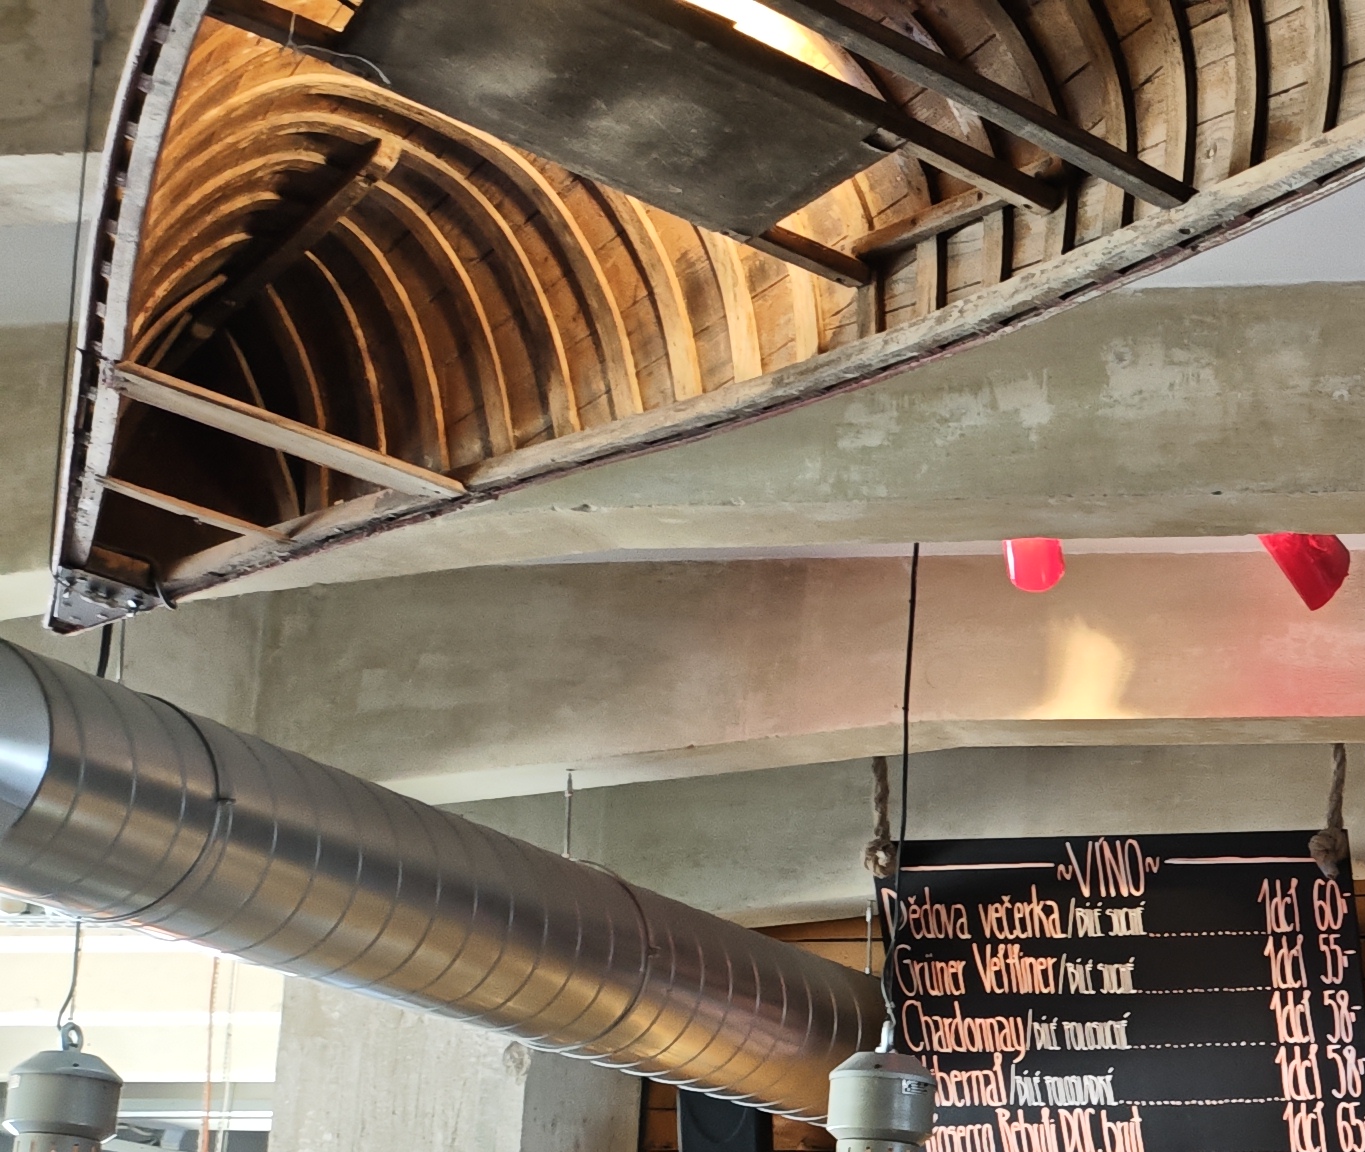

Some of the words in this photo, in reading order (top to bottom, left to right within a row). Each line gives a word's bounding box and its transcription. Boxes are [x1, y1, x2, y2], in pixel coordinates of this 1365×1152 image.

[1065, 837, 1146, 898] VÍNO
[881, 886, 972, 941] Dědova
[1257, 877, 1301, 934] 1dcl
[894, 944, 967, 996] Grüner
[1263, 933, 1308, 989] 1dcl
[1270, 990, 1316, 1044] 1dcl
[1274, 1043, 1322, 1101] 1dcl
